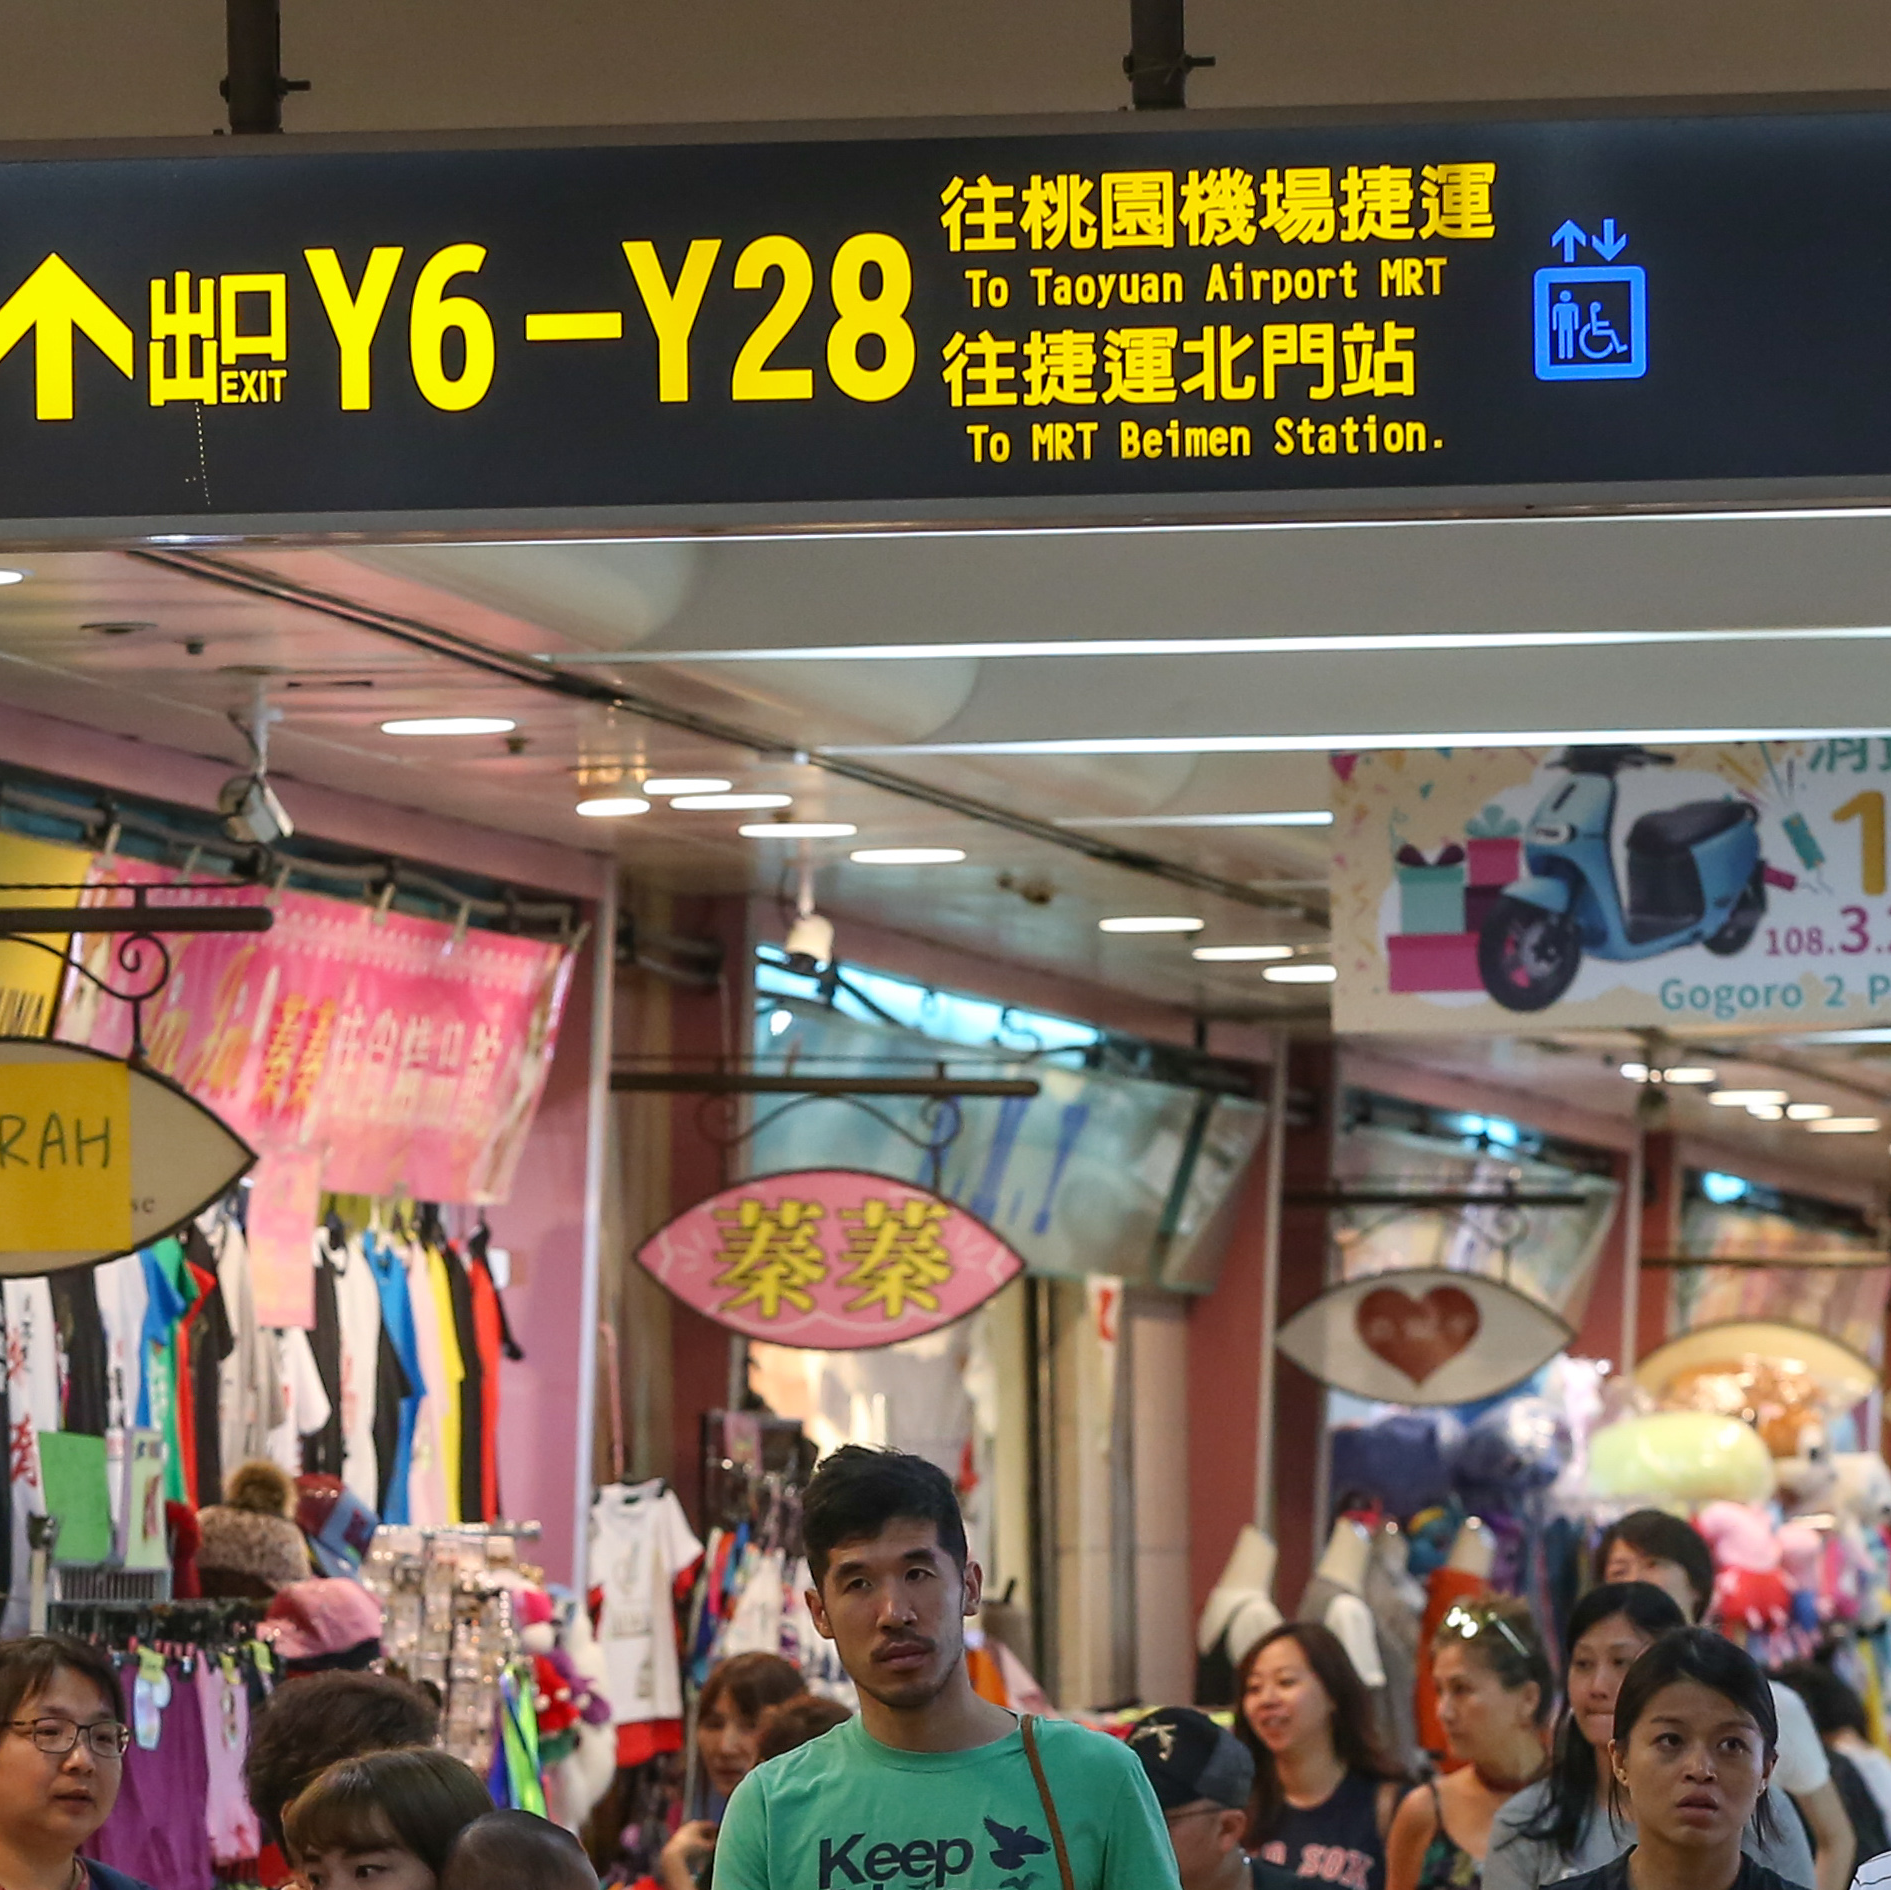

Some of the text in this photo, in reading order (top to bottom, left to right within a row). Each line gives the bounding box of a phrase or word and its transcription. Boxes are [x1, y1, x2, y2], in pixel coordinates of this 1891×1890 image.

[941, 163, 1495, 251] 往桃園機場捷運
[965, 258, 1447, 309] To Taoyuan Airport MRT
[150, 271, 287, 406] 出口
[943, 321, 1414, 406] 往捷運北門站
[221, 370, 287, 403] EXIT
[967, 425, 1009, 462] To
[1032, 422, 1098, 461] MRT
[1121, 420, 1250, 458] Beimen
[1660, 976, 1803, 1020] Gogoro
[1824, 976, 1848, 1007] 2
[819, 1833, 974, 1889] Keep
